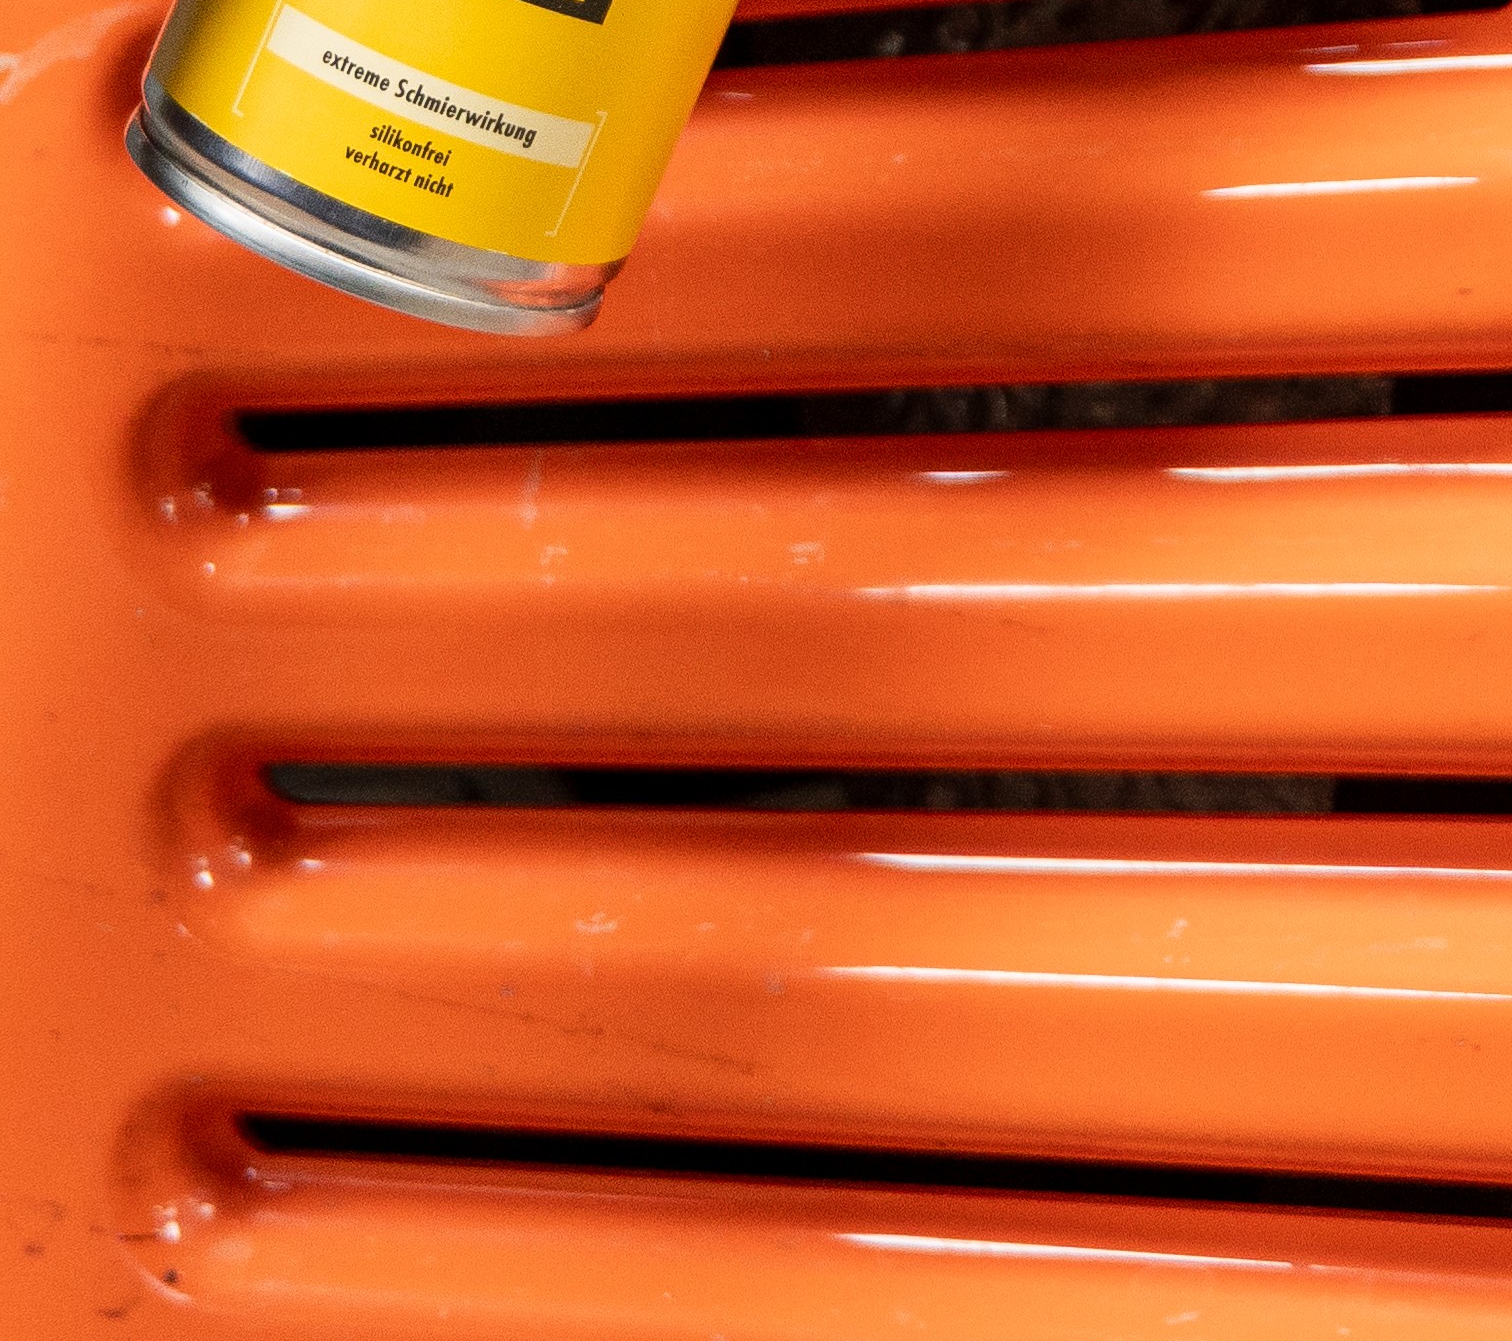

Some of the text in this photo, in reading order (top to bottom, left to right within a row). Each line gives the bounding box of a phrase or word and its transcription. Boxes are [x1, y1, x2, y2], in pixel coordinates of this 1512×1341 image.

[321, 46, 538, 150] extreme Schmierwirkung
[344, 145, 455, 199] verharzt nicht
[369, 122, 453, 168] silikonfrei
